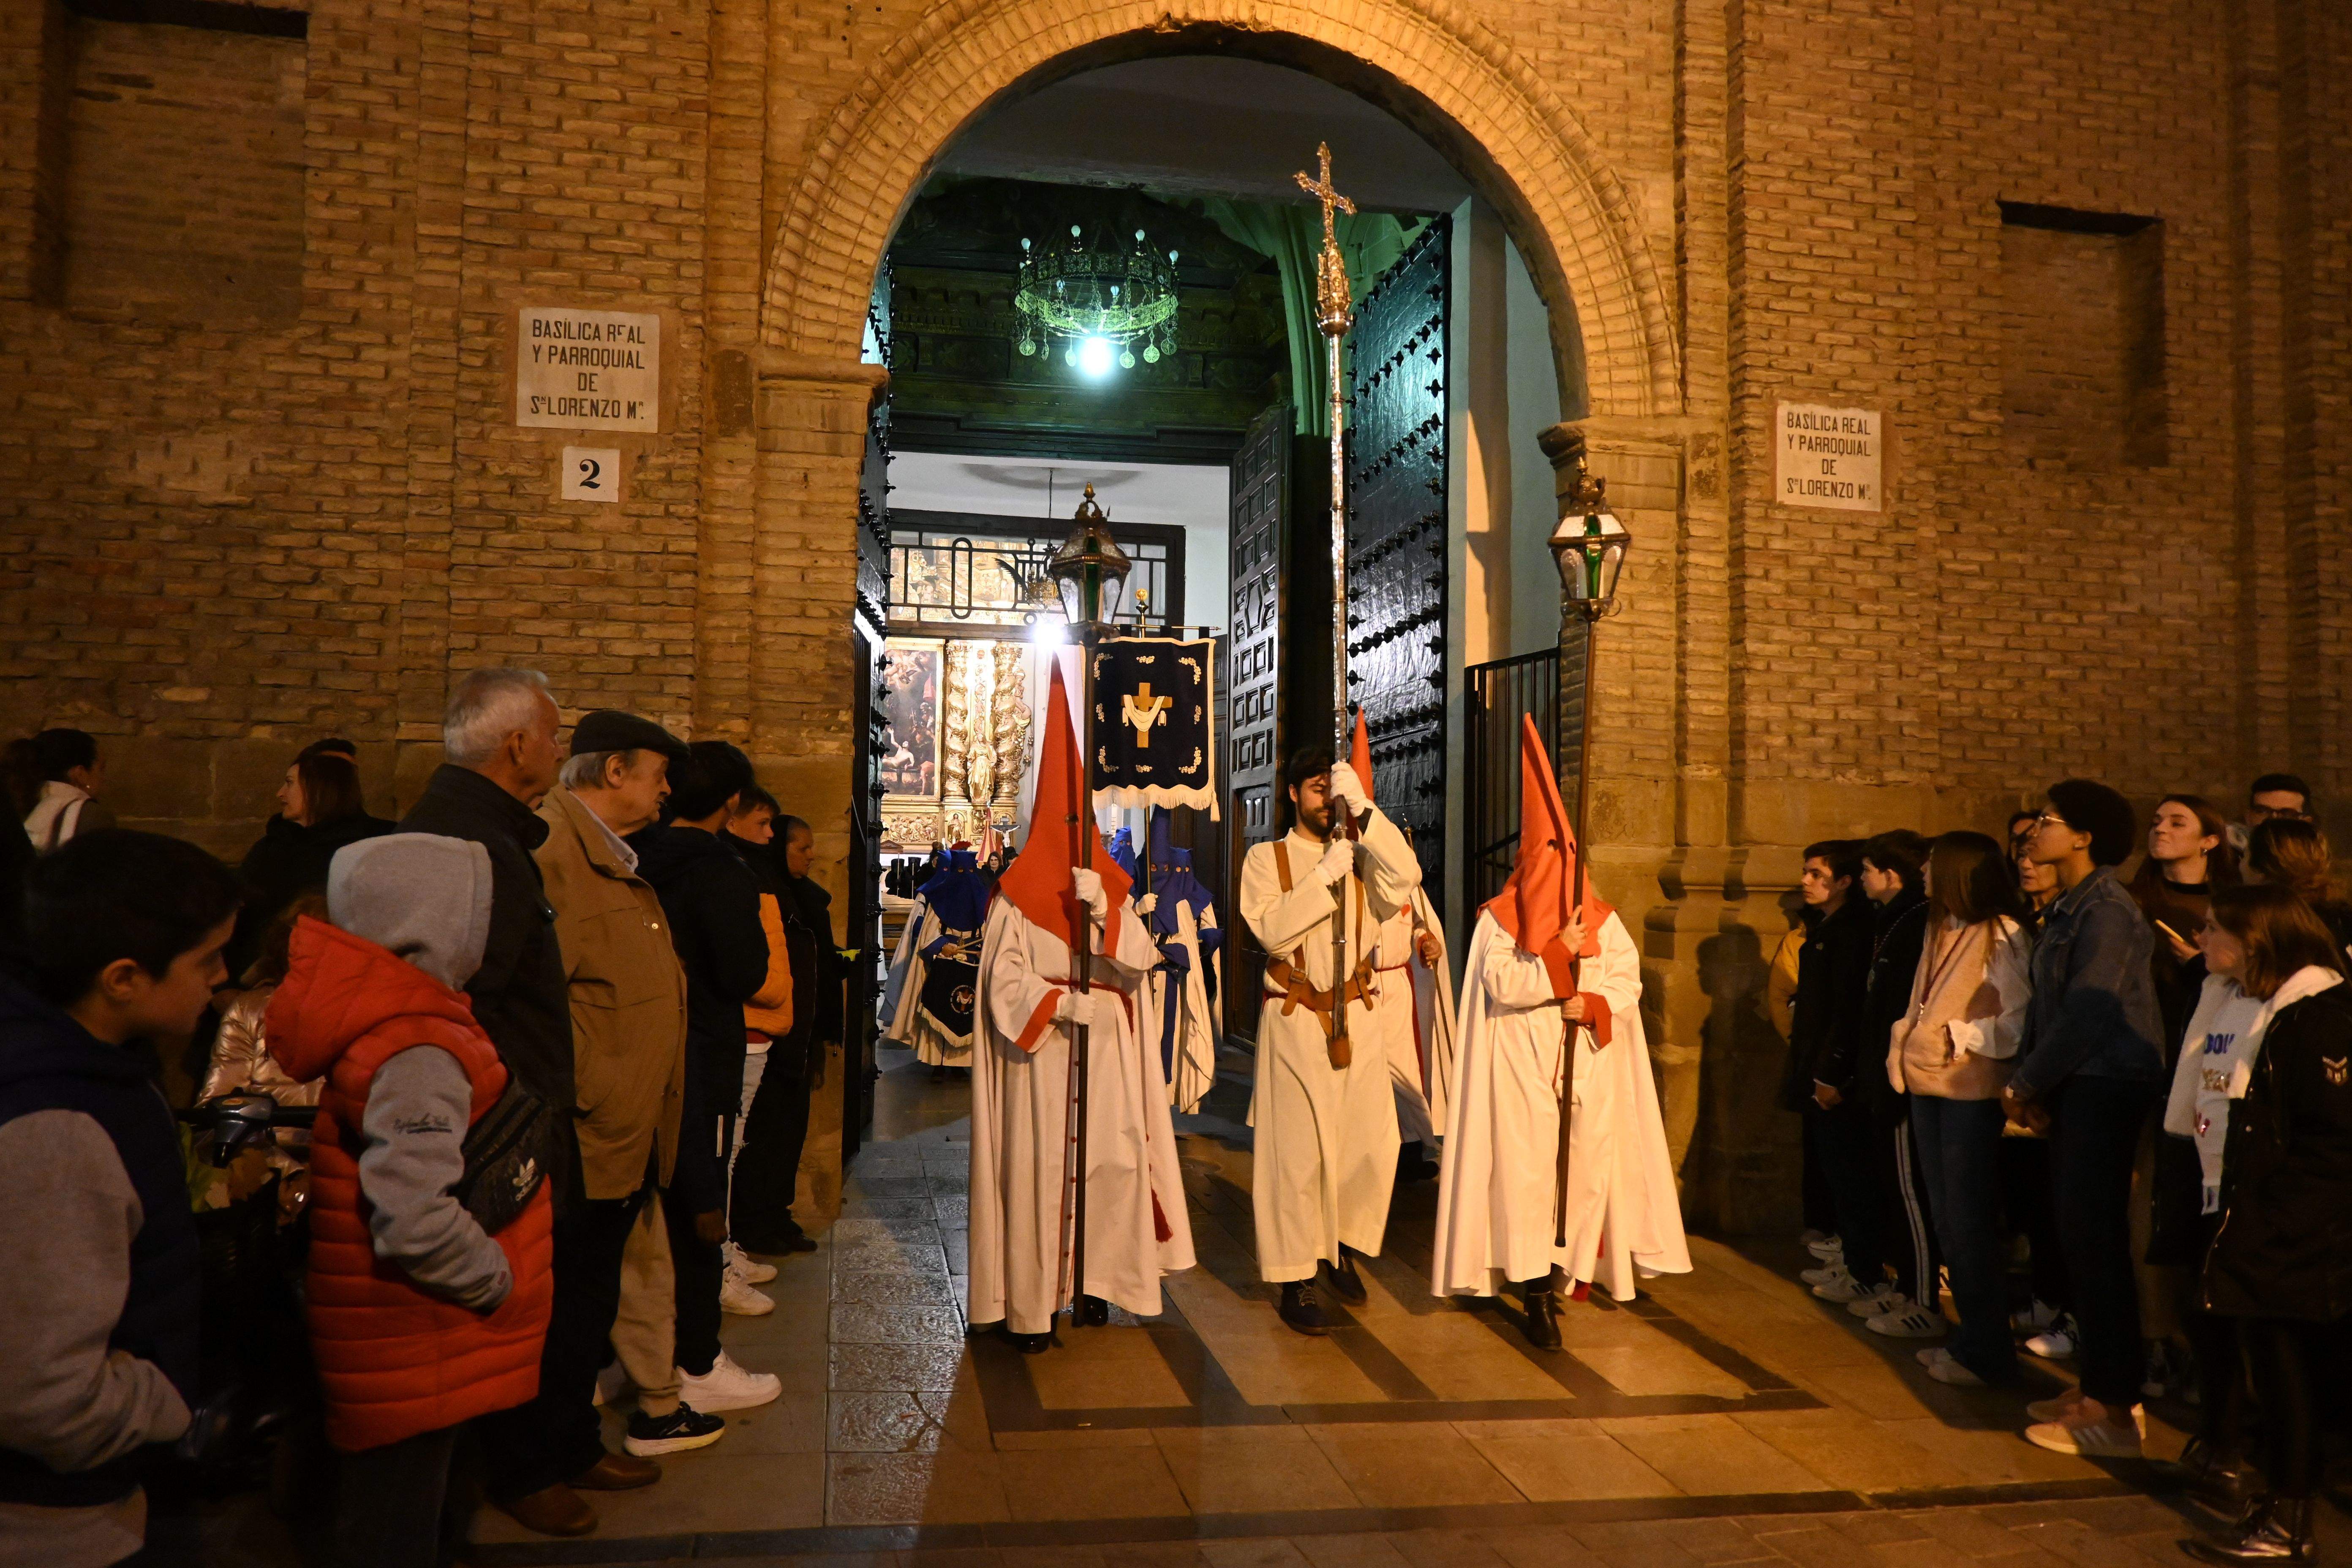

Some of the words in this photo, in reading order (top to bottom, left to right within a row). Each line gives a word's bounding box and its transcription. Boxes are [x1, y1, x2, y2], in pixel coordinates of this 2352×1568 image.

[533, 318, 601, 341] BASÍLICA
[607, 324, 645, 344] REAL
[533, 344, 541, 363] Y
[548, 345, 645, 369] PARROQUIAL
[578, 372, 598, 392] DE
[548, 397, 620, 418] LORENZO
[1787, 411, 1838, 432] BASÍLICA
[1842, 417, 1871, 435] REAL
[1788, 434, 1794, 449] Y
[1799, 435, 1871, 456] PARROQUIAL
[579, 459, 601, 489] 2
[1822, 458, 1837, 475] DE
[1800, 479, 1854, 498] LORENZO
